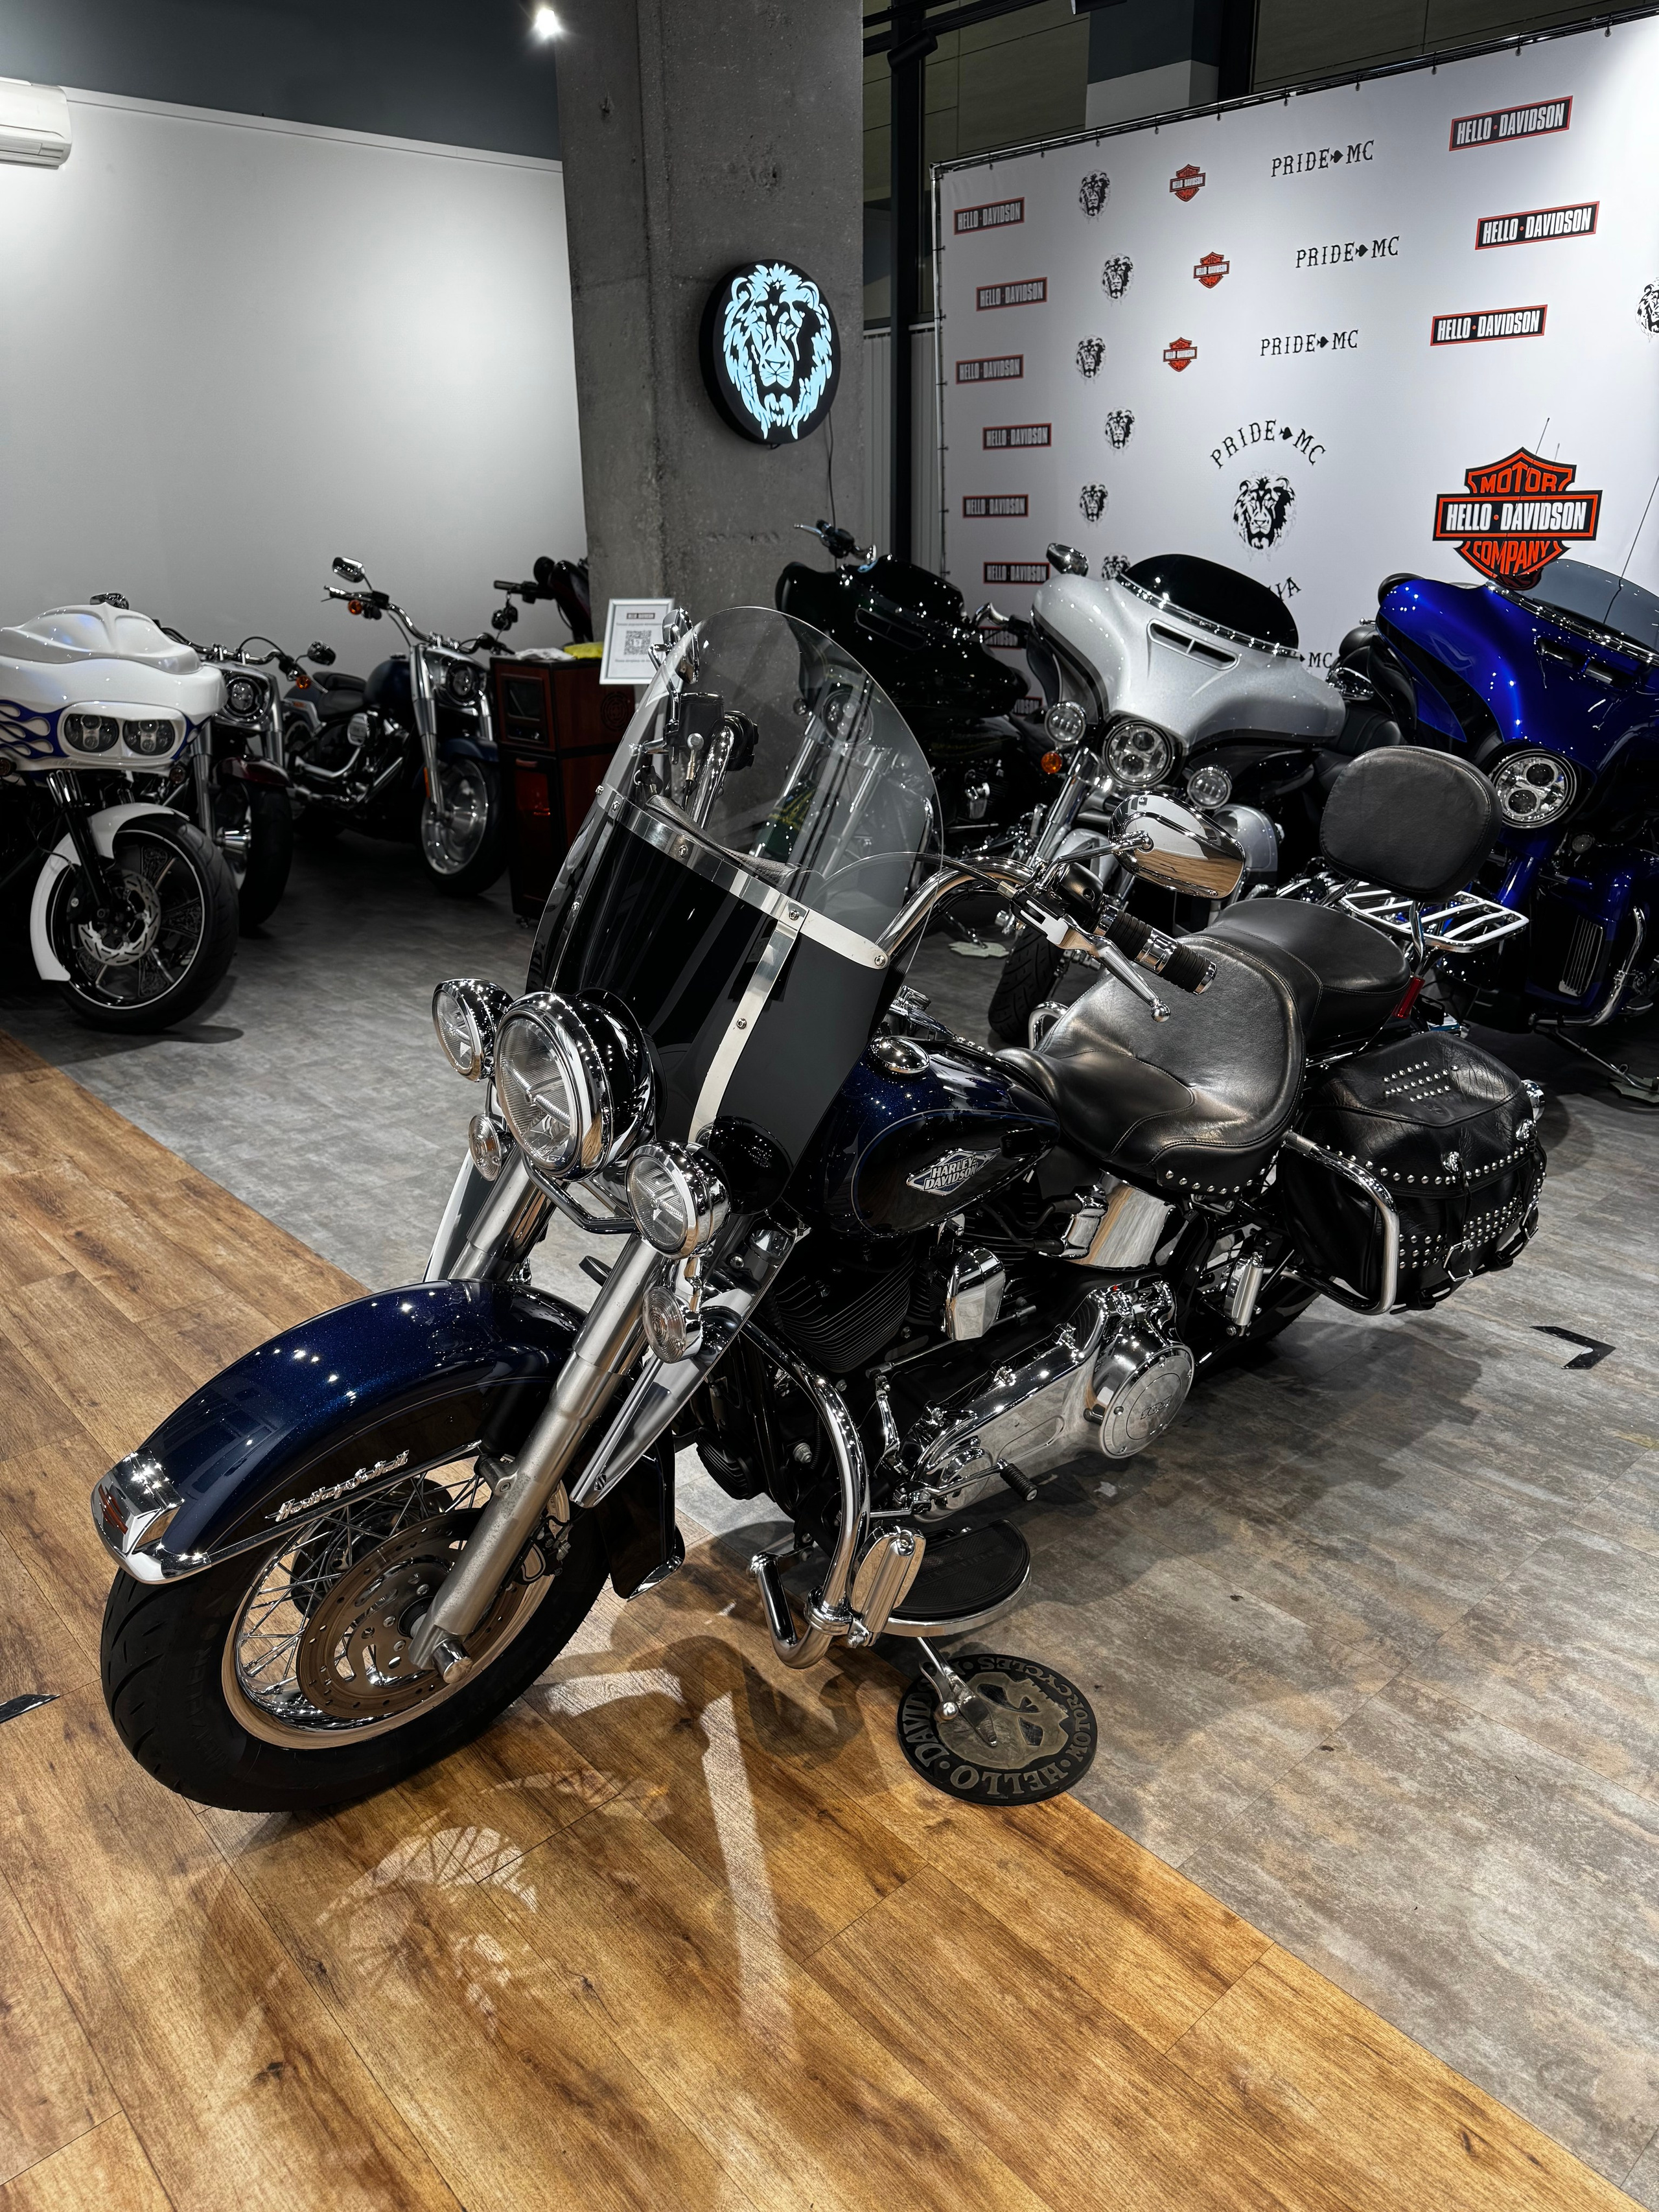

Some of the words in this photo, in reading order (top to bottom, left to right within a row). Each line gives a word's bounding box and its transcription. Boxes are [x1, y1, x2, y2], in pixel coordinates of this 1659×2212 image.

[1456, 117, 1492, 145] HELLO
[1498, 102, 1565, 138] DAVIDSON
[1271, 148, 1330, 178] PRIDE
[1346, 141, 1375, 165] MC
[957, 211, 979, 231] HELLO
[982, 202, 1021, 226] DAVIDSON
[1482, 218, 1519, 245] HELLO
[1525, 207, 1592, 239] DAVIDSON
[1295, 242, 1355, 268] PRIDE
[1371, 236, 1400, 259] MC
[980, 288, 1001, 307] HELLO
[1005, 281, 1043, 304] DAVIDSON
[1437, 316, 1472, 342] HELLO
[1477, 310, 1540, 338] DAVIDSON
[1260, 334, 1316, 356] PRIDE
[1332, 329, 1359, 349] MC
[959, 363, 980, 380] HELLO
[983, 358, 1020, 378] DAVIDSON
[986, 430, 1006, 447] HELLO
[1010, 427, 1048, 445] DAVIDSON
[1209, 419, 1277, 469] PRIDE
[1292, 428, 1327, 465] MC
[1479, 461, 1557, 494] MOTOR
[966, 499, 986, 515] HELLO
[989, 498, 1025, 515] DAVIDSON
[1446, 503, 1492, 531] HELLO
[1500, 502, 1587, 531] DAVIDSON
[1473, 541, 1549, 576] COMPANY
[986, 565, 1007, 581] HELLO
[1010, 565, 1047, 582] DAVIDSON
[1308, 652, 1332, 668] MC
[925, 1164, 978, 1190] DAVIDSON
[950, 1762, 1069, 1795] HELLO
